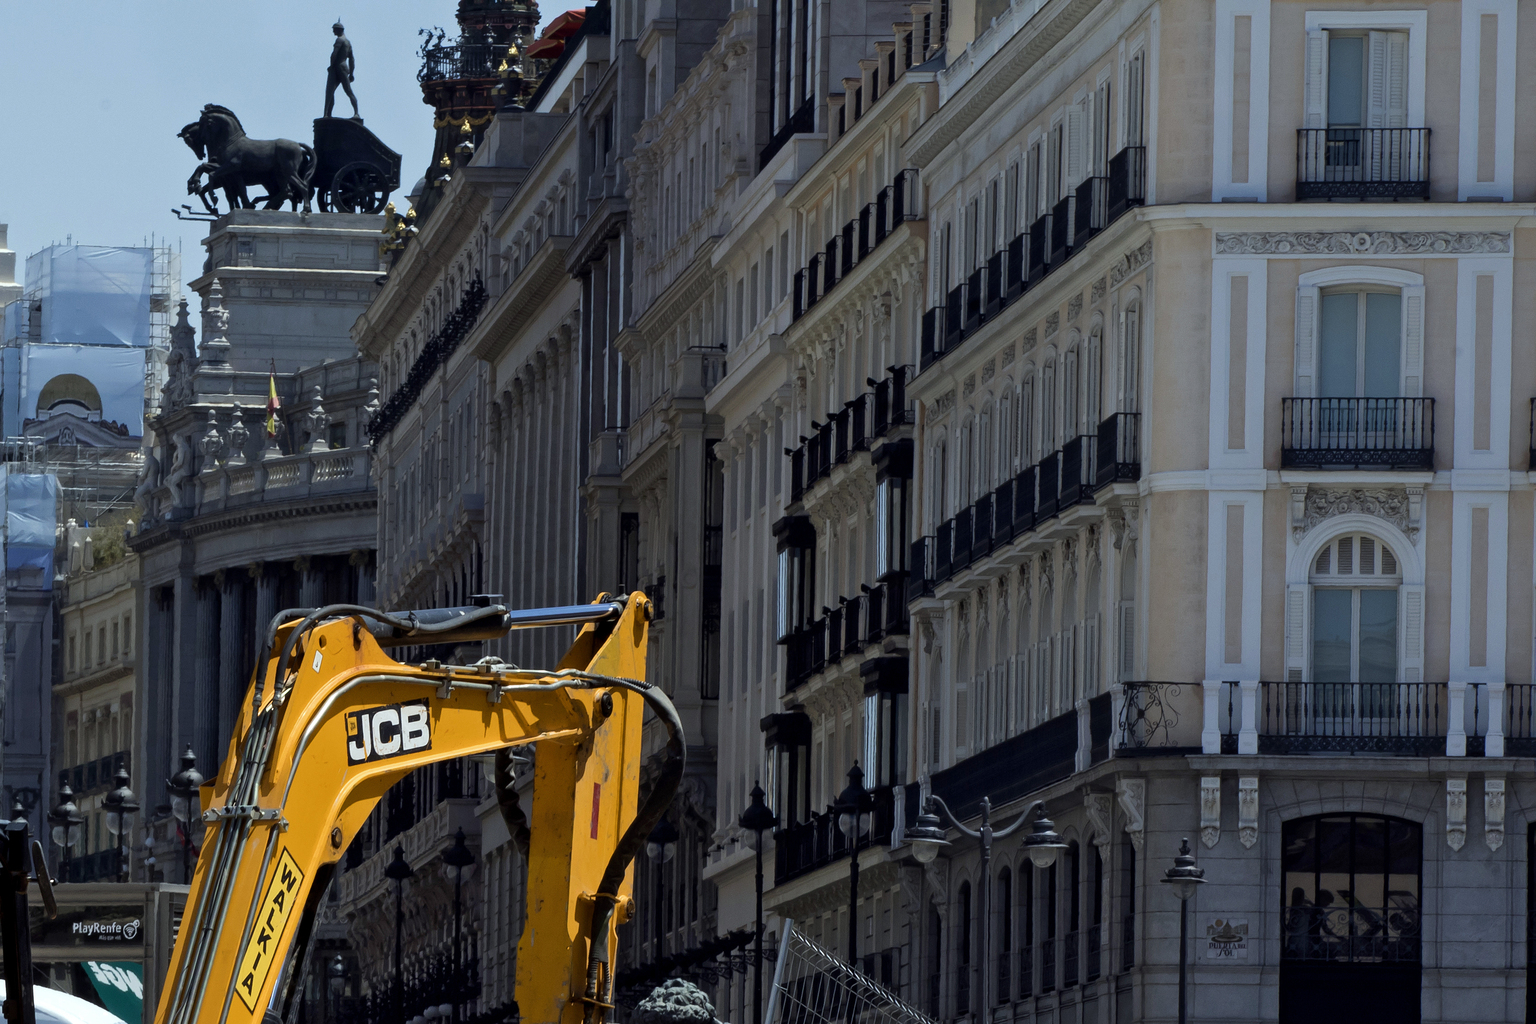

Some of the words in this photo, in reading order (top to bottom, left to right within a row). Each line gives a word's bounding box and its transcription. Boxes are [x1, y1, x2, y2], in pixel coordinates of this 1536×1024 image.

[348, 703, 431, 761] JCB
[72, 921, 122, 936] PlayRenfe
[241, 862, 297, 997] WALKIA
